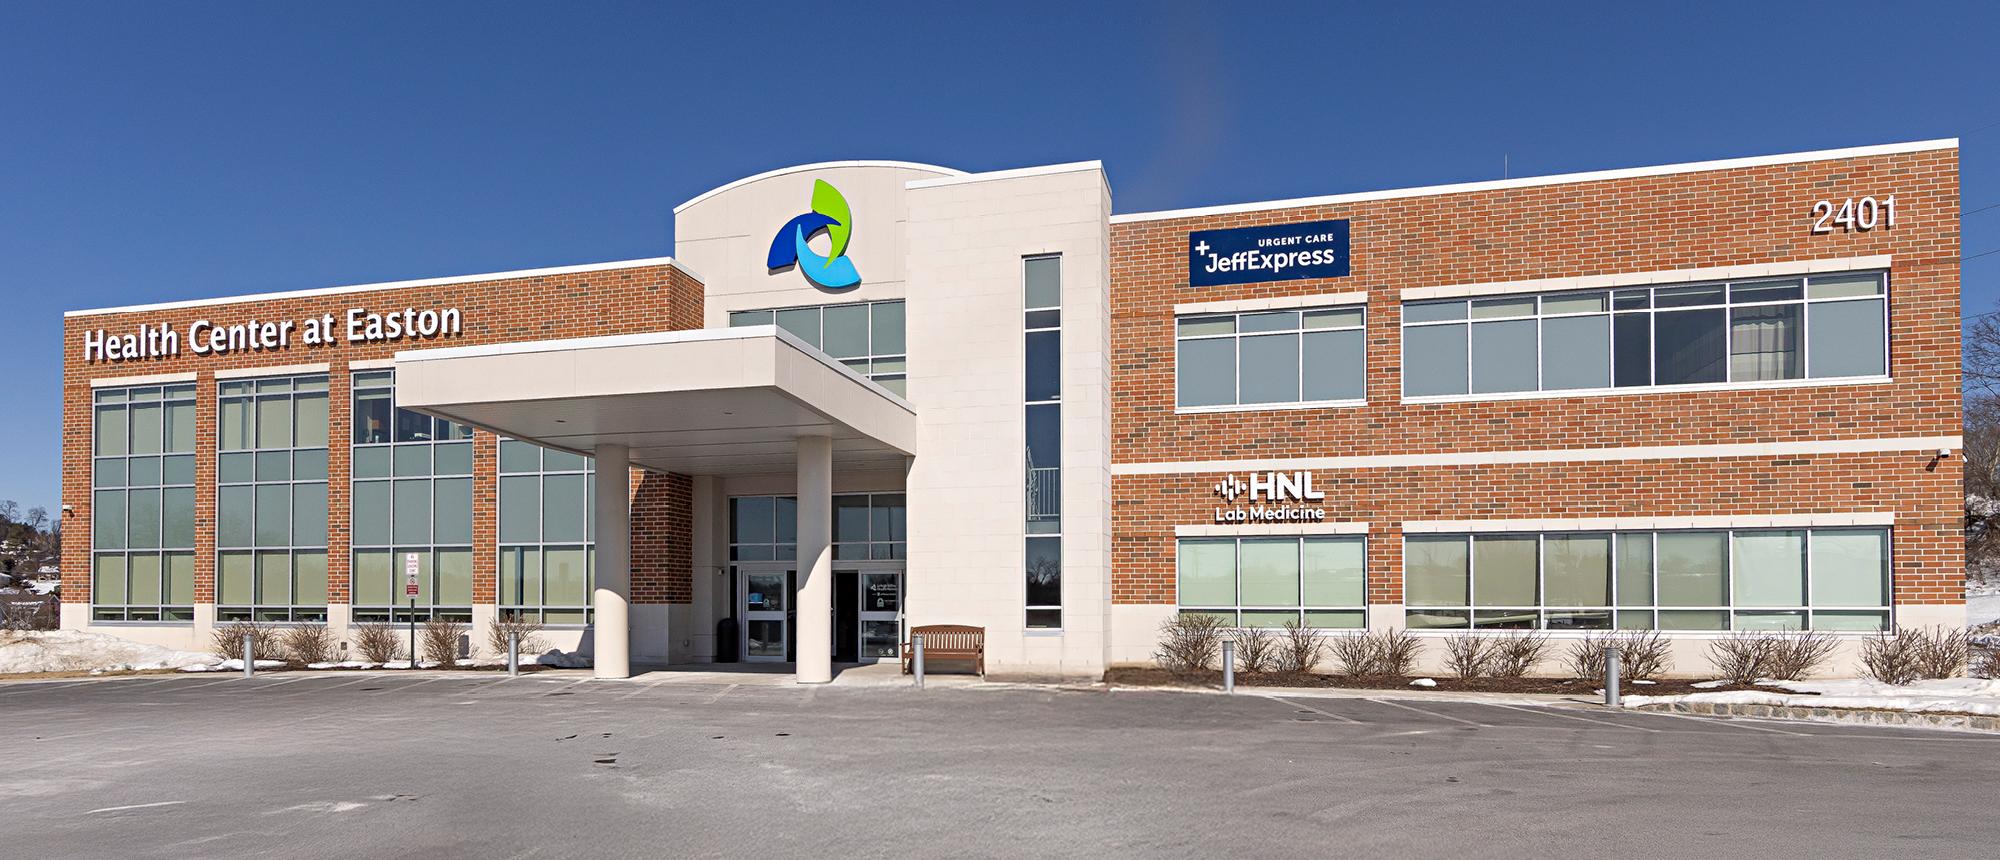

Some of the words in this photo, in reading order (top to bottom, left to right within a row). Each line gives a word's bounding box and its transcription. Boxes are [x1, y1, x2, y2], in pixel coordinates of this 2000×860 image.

[1813, 195, 1895, 232] 2401
[1258, 236, 1302, 247] URGENT
[1305, 233, 1334, 244] CARE
[1205, 249, 1335, 273] JeffExpress
[84, 322, 178, 361] Health
[189, 319, 293, 353] Center
[303, 313, 335, 345] at
[347, 307, 461, 341] Easton
[1249, 471, 1325, 501] HNL
[1215, 506, 1246, 521] Lab
[1250, 505, 1325, 520] Medicine
